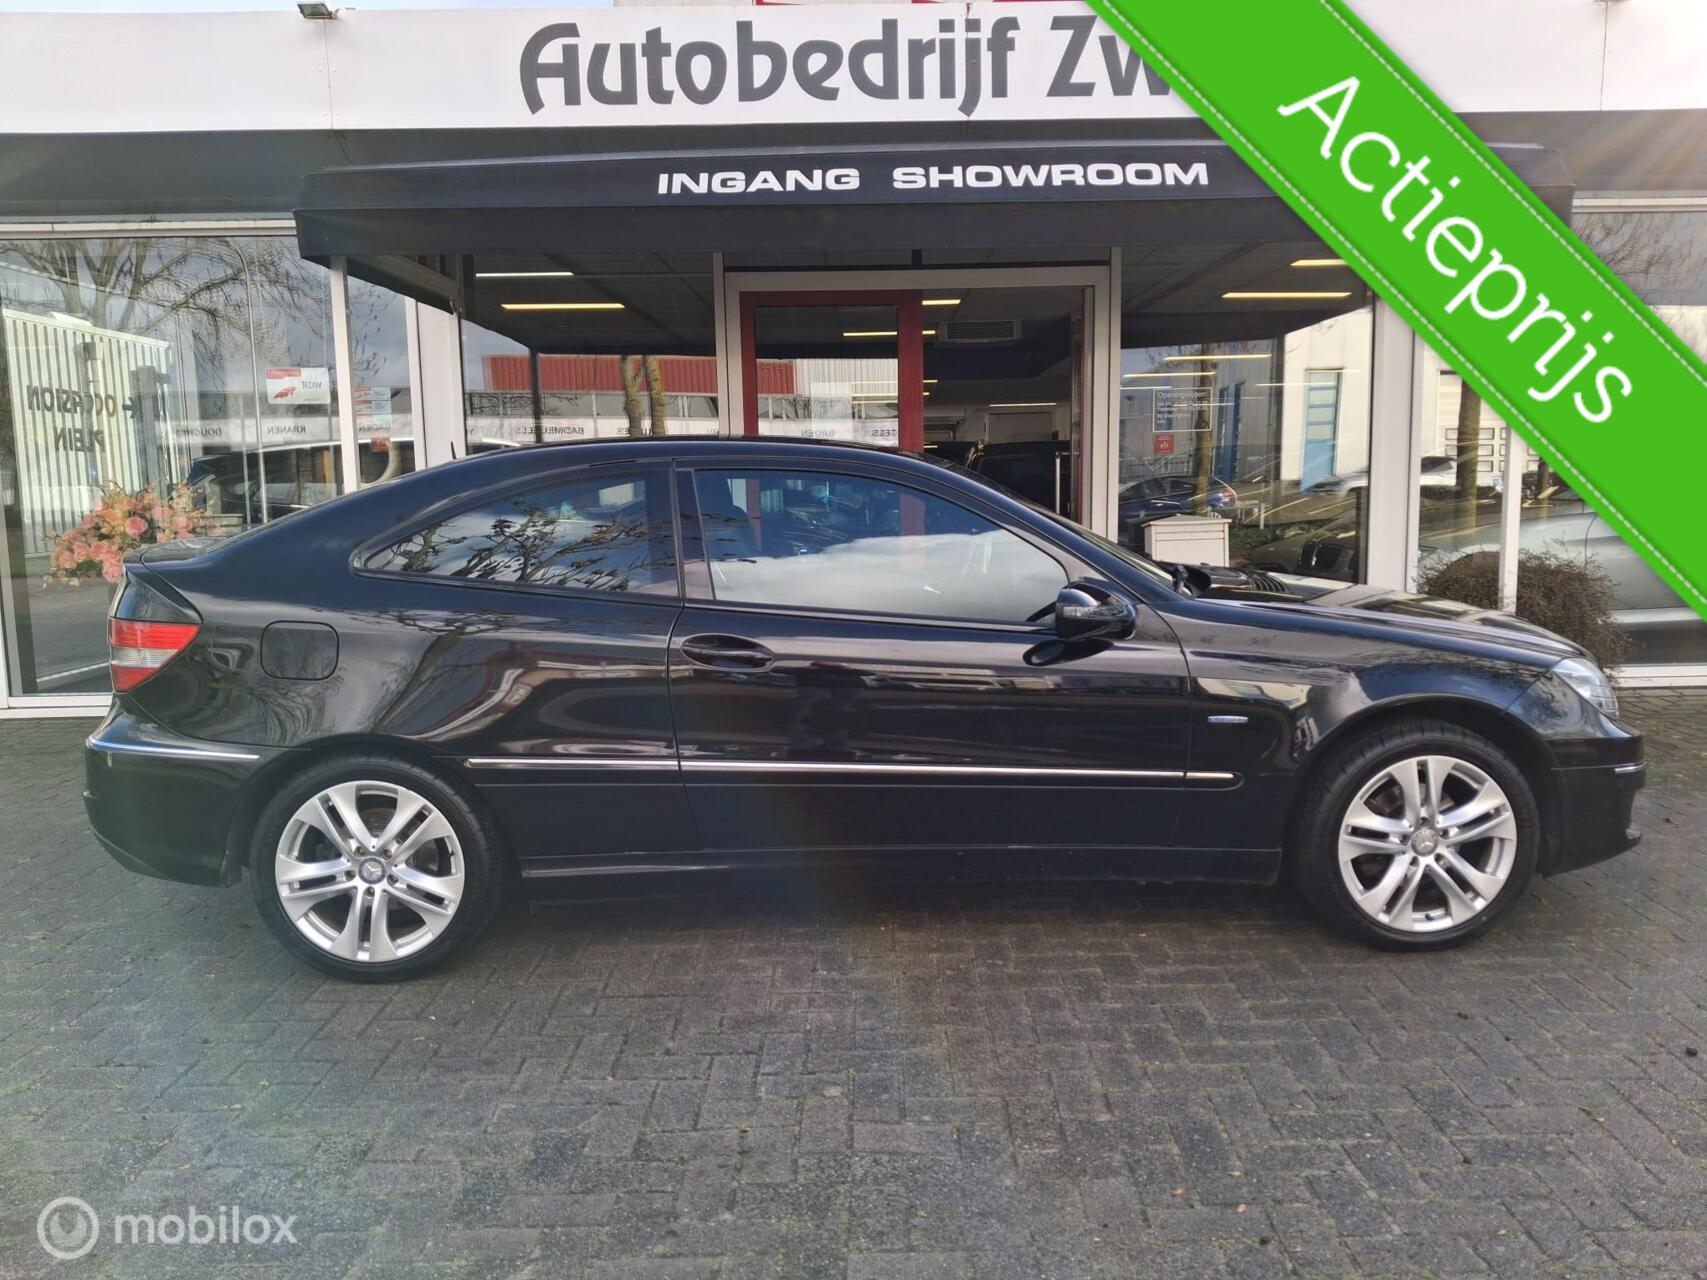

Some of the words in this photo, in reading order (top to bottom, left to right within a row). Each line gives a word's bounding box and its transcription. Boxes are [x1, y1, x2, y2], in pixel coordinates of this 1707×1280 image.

[519, 16, 1020, 117] Autobedrijf
[657, 168, 861, 194] INGANG
[892, 162, 1210, 189] SHOWROOM
